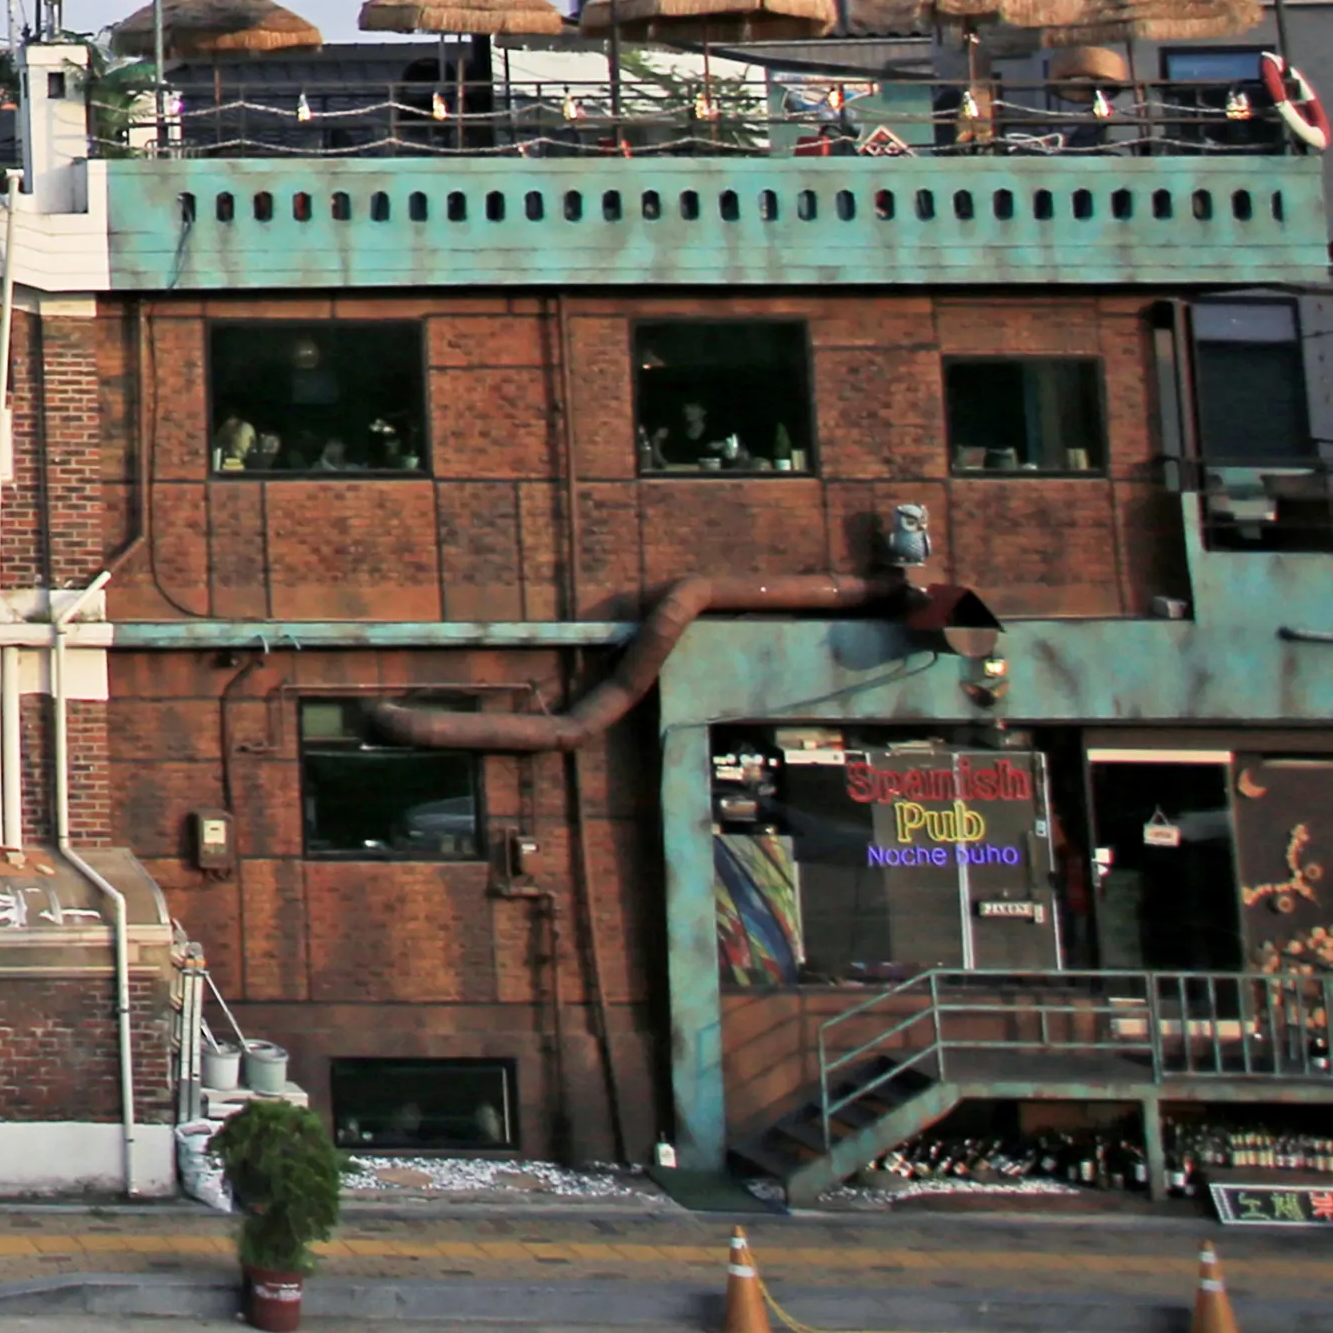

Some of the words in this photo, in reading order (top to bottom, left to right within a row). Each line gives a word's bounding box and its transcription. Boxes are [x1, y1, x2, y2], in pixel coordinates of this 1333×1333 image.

[846, 756, 1031, 804] Spanish
[894, 800, 986, 843] Pub
[867, 844, 948, 866] Noche
